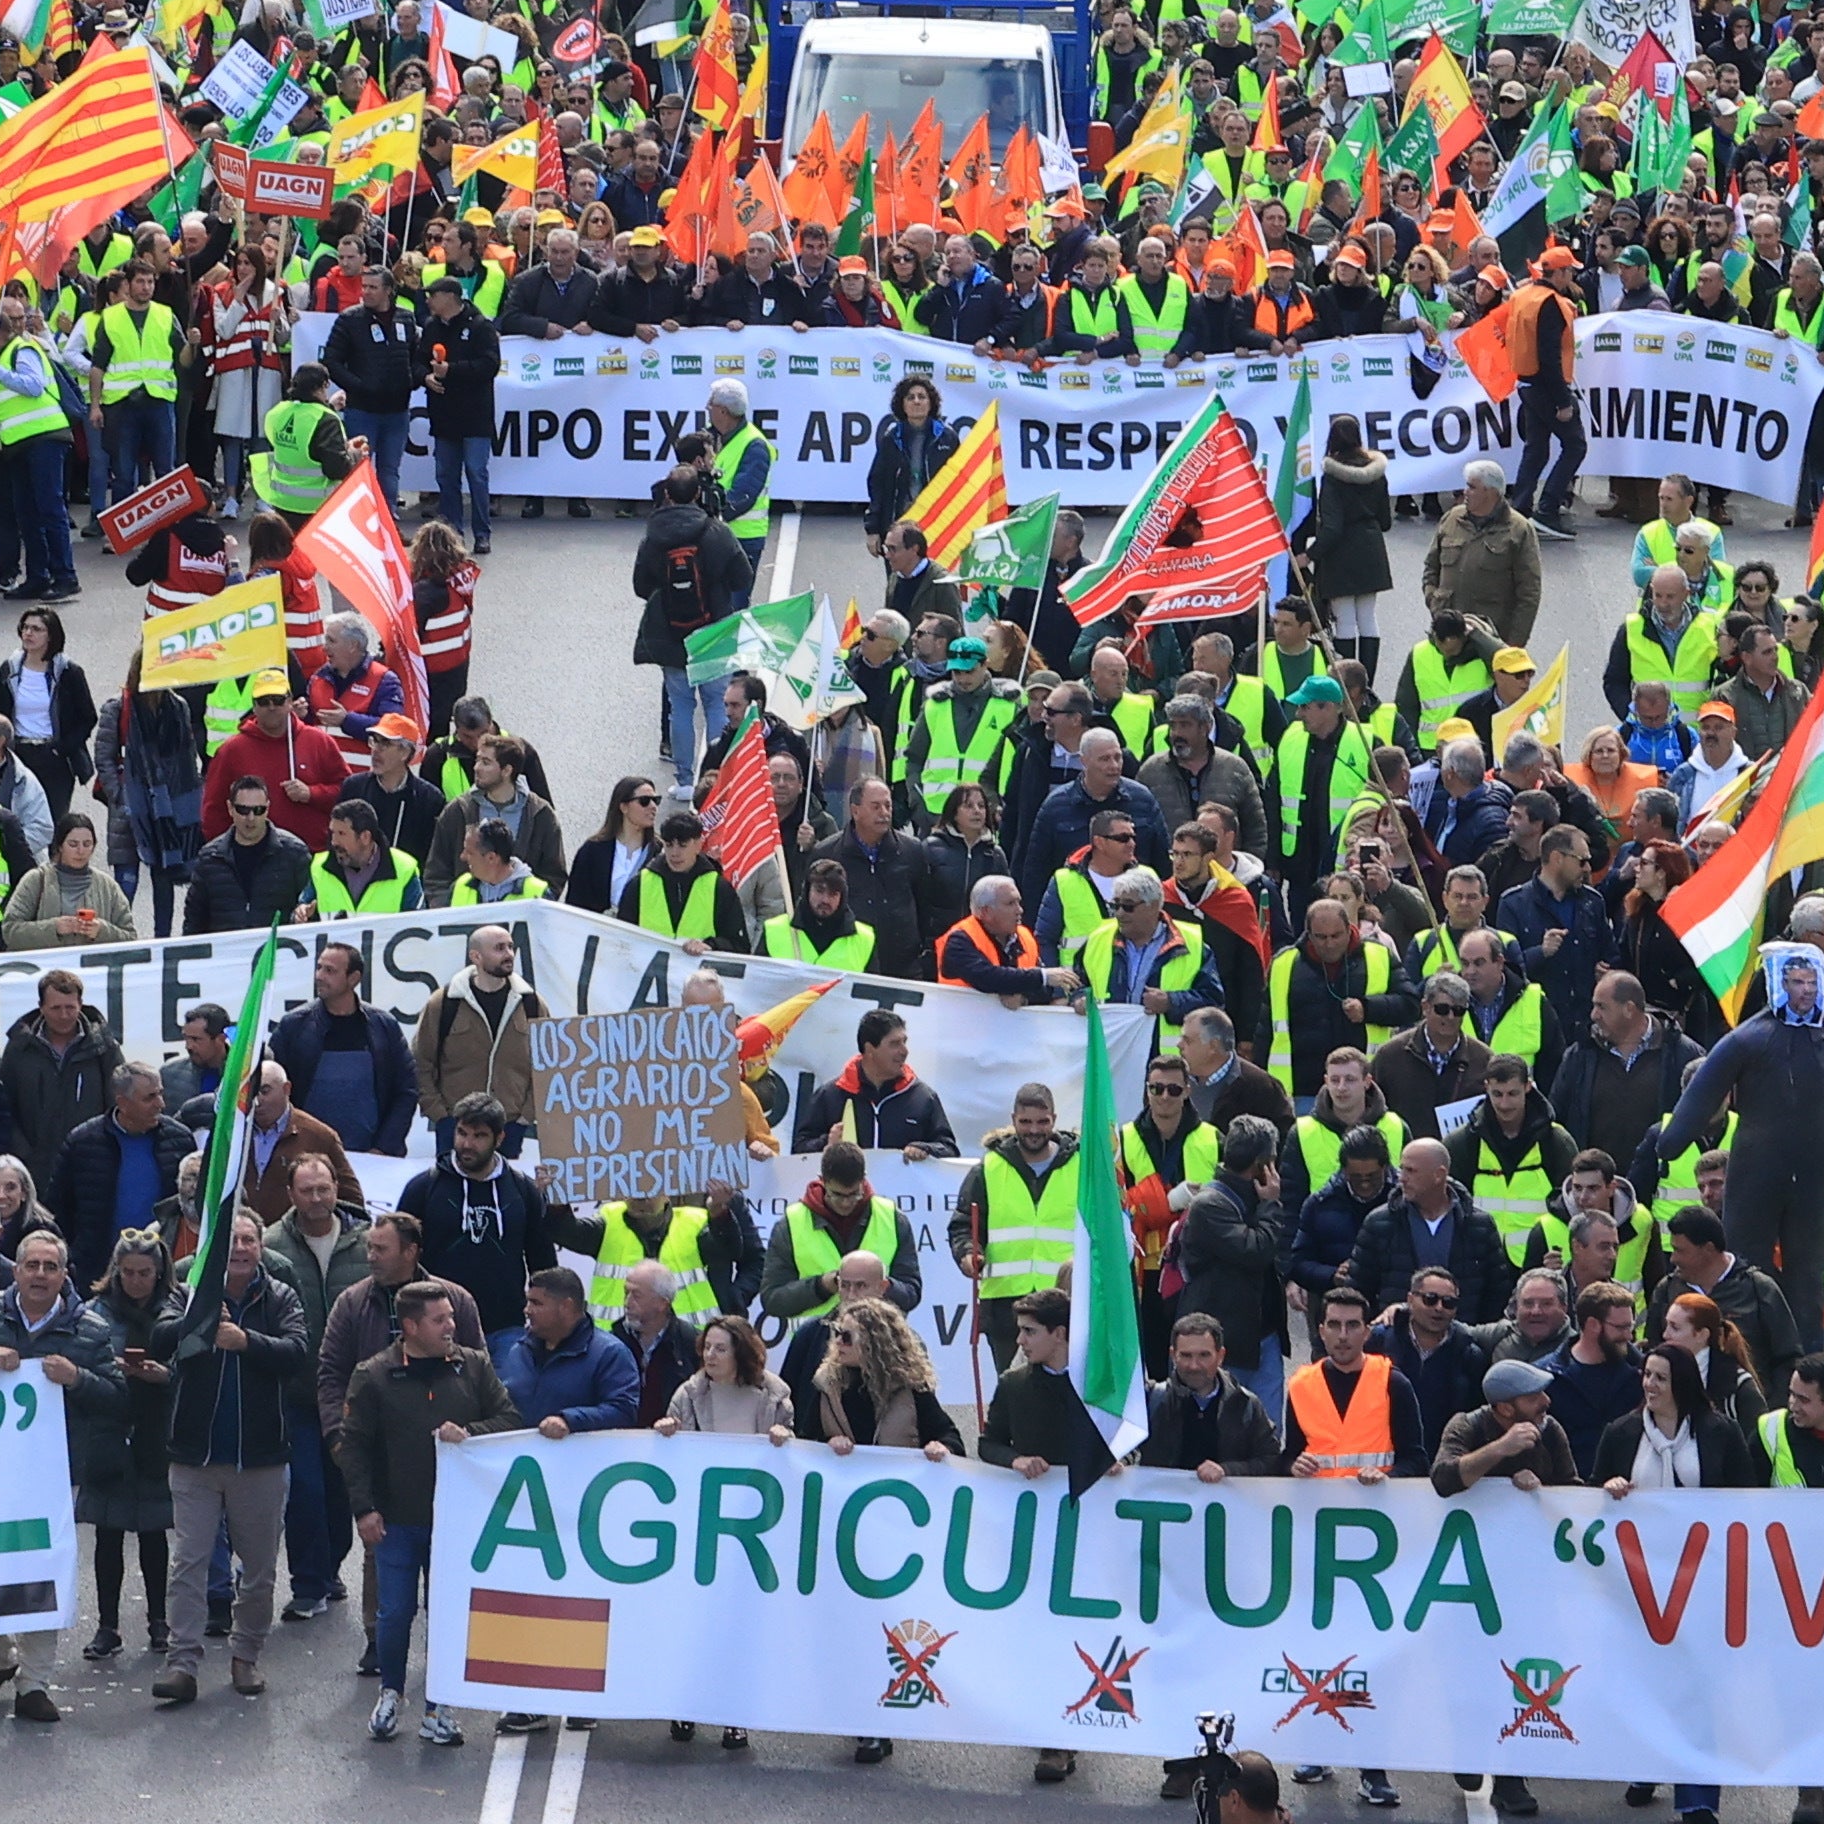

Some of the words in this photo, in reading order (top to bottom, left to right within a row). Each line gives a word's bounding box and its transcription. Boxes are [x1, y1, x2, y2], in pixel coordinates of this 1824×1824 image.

[218, 154, 247, 178] UAGN
[259, 175, 323, 196] UAGN
[520, 373, 541, 383] UPA
[598, 358, 627, 369] COAG
[639, 370, 661, 380] UPA
[716, 358, 744, 369] COAG
[757, 369, 777, 379] UPA
[831, 360, 861, 372] COAG
[872, 373, 893, 383] UPA
[946, 366, 976, 377] COAG
[988, 380, 1008, 390] UPA
[1060, 375, 1090, 385] COAG
[1102, 384, 1123, 394] UPA
[1216, 379, 1236, 389] UPA
[1331, 373, 1352, 384] UPA
[1449, 369, 1469, 379] UPA
[1634, 336, 1665, 347] COAG
[1674, 352, 1694, 363] UPA
[1746, 351, 1773, 366] COAG
[1780, 372, 1797, 386] UPA
[404, 407, 602, 461] CMPO
[1019, 417, 1258, 472] RESPEO
[118, 480, 187, 530] UAGN
[182, 546, 225, 566] UAGN
[530, 1019, 577, 1071] LOS
[579, 1004, 738, 1068] SINDICATOS
[544, 1061, 732, 1114] AGRARIOS
[573, 1110, 623, 1154] NO
[653, 1107, 715, 1147] ME
[541, 1139, 750, 1205] REPRESENTAN
[471, 1454, 1503, 1636] AGRICULTURA
[884, 1678, 936, 1709] UPA
[1068, 1711, 1129, 1730] ASAJA
